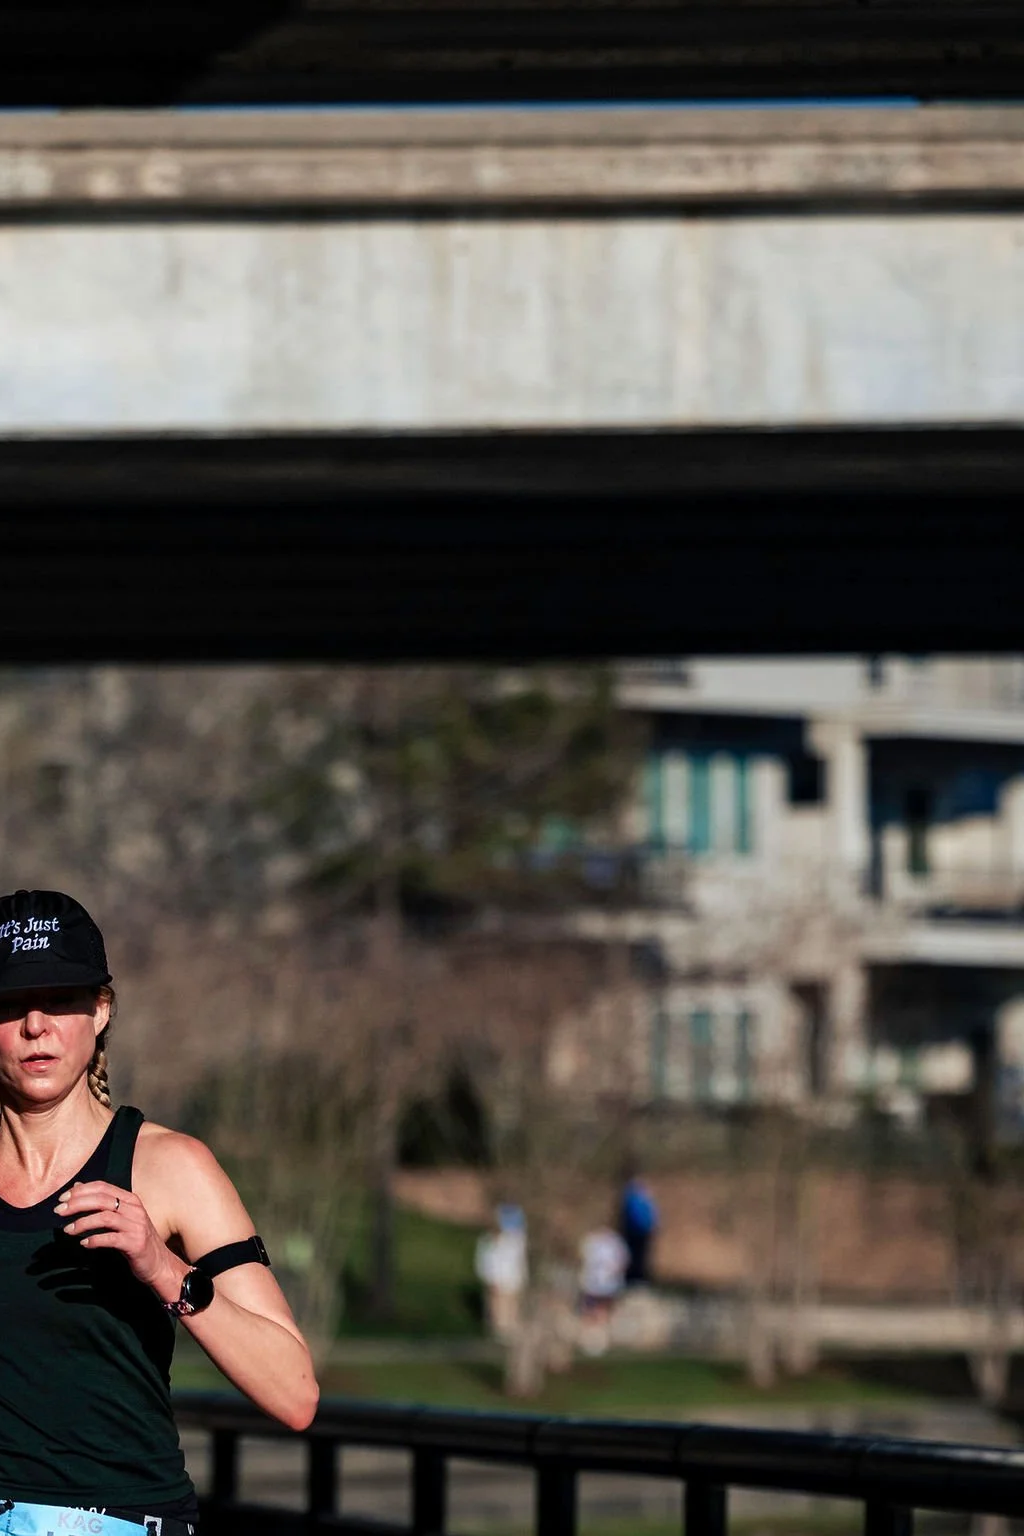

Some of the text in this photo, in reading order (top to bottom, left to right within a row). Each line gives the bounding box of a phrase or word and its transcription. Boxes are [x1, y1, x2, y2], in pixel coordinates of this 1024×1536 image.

[23, 917, 60, 934] Just
[11, 933, 50, 954] Pain
[57, 1511, 103, 1534] KAG
